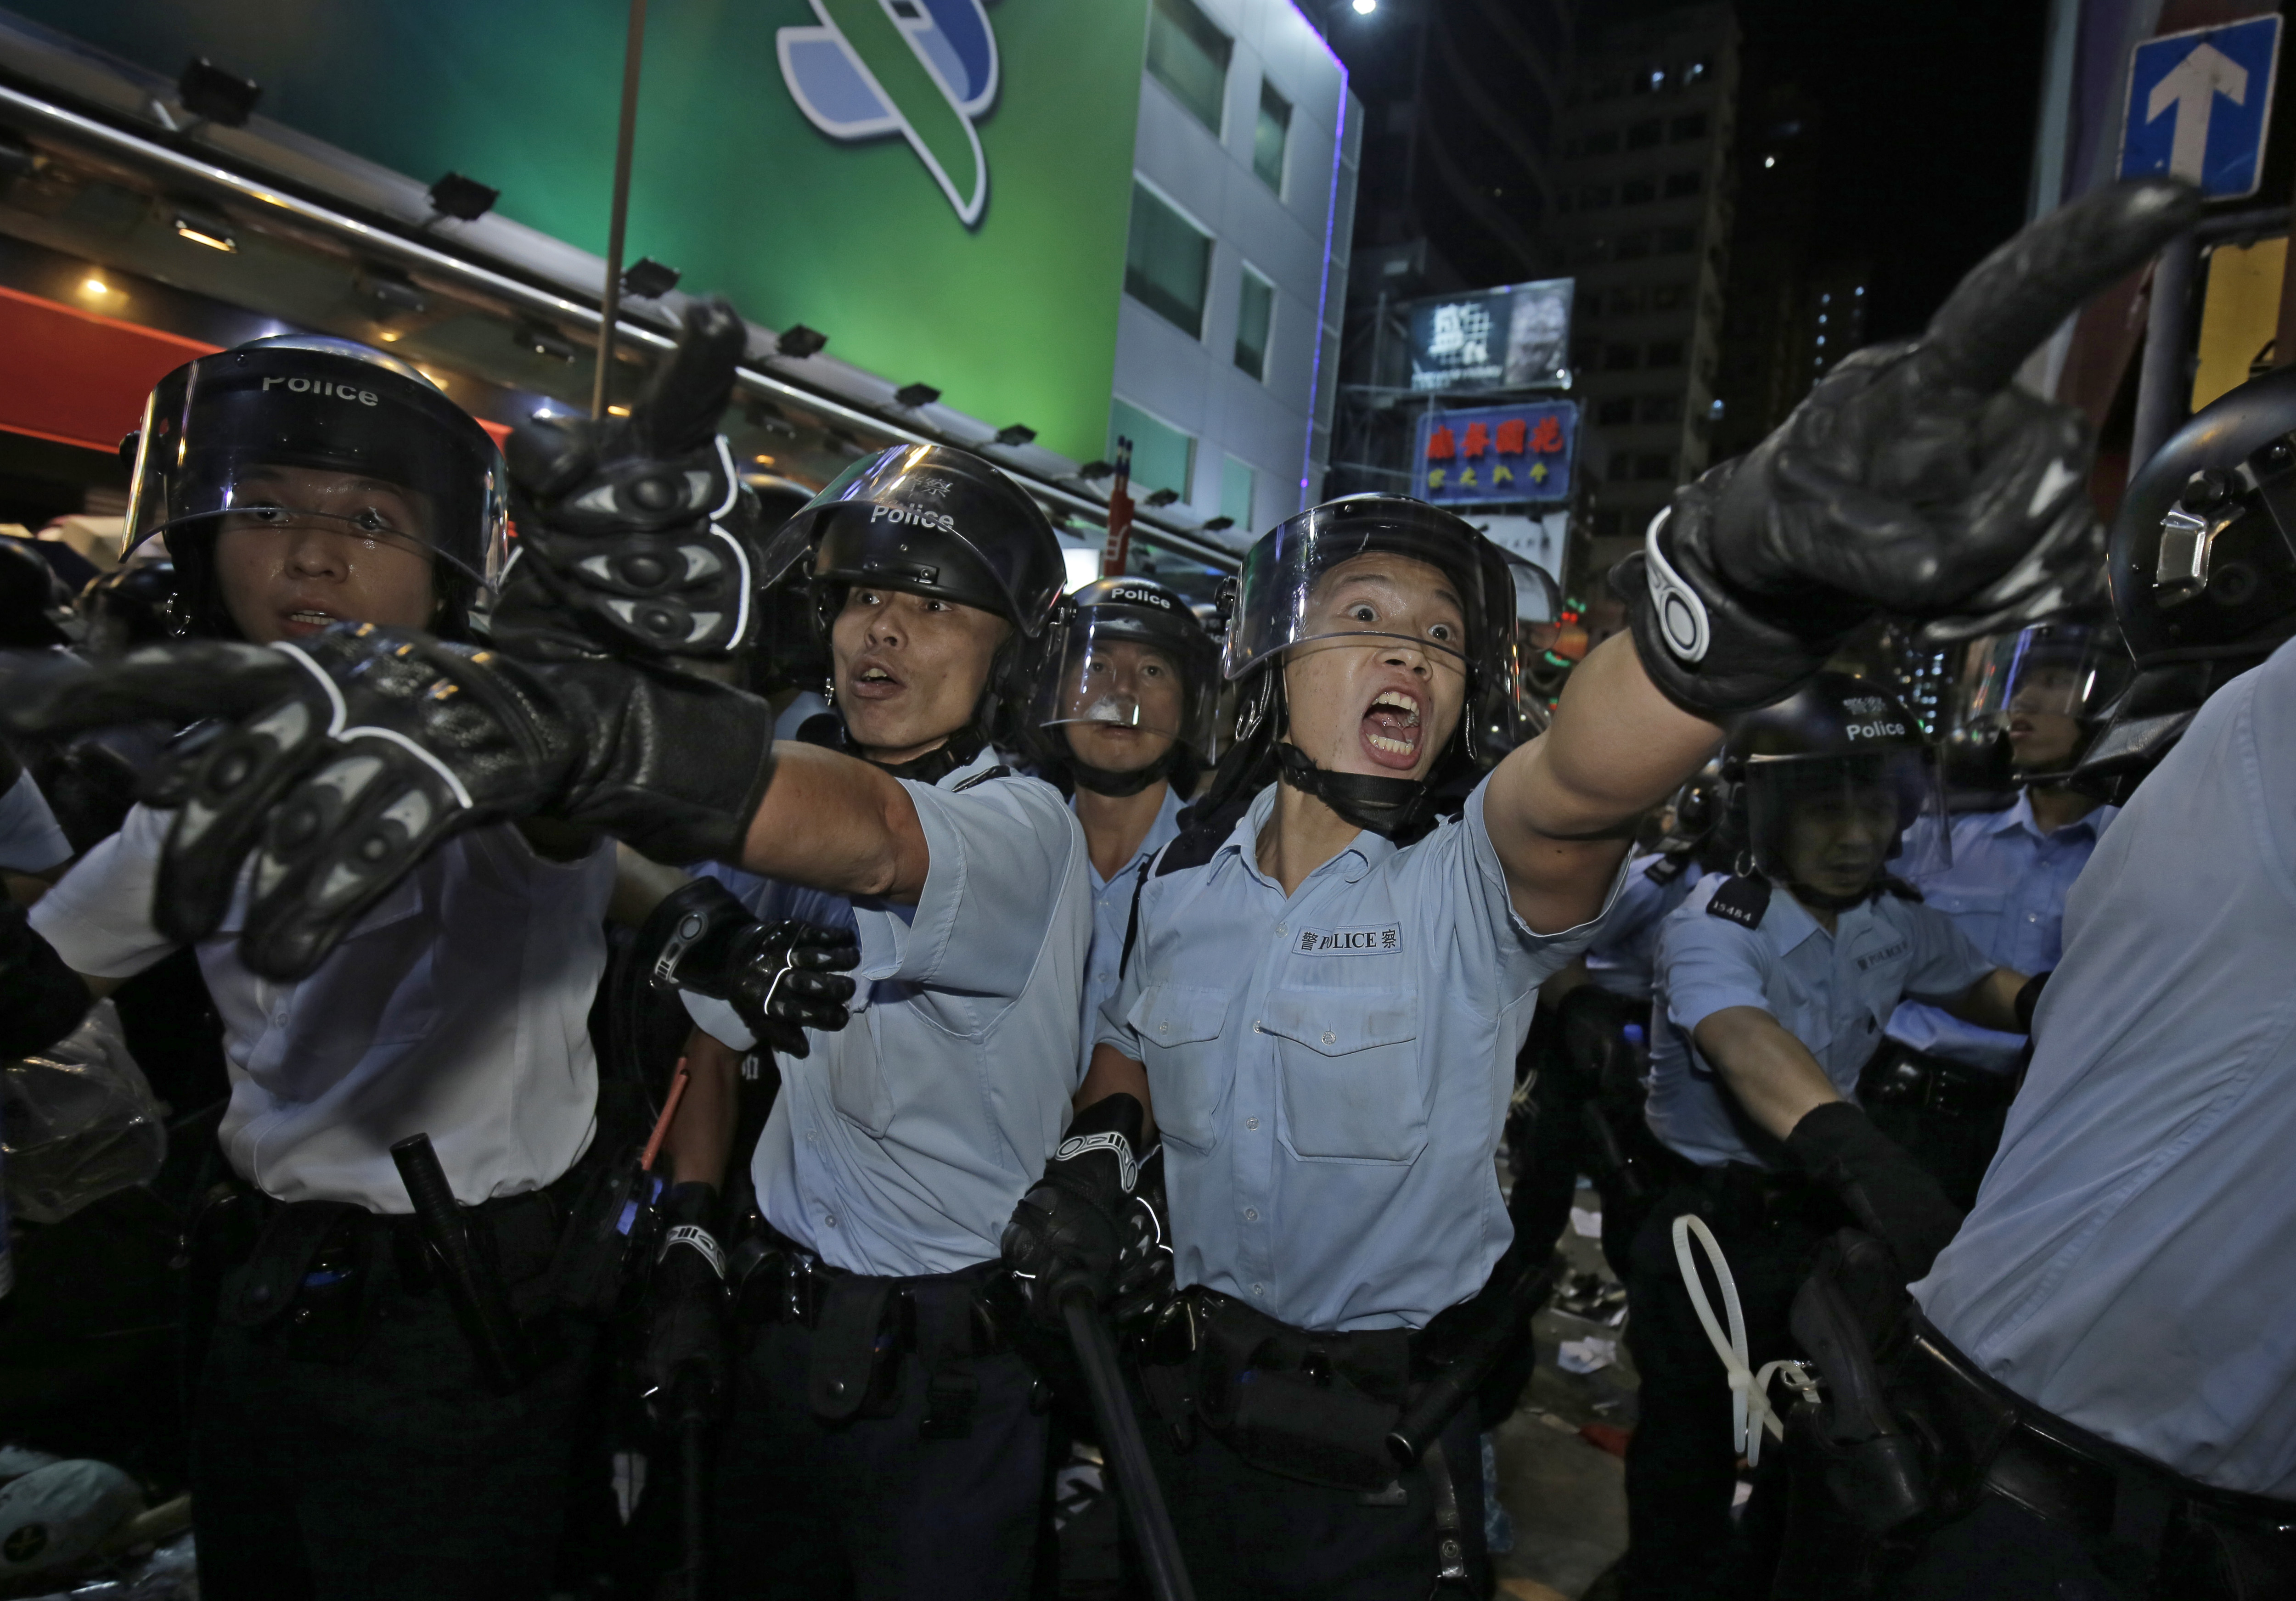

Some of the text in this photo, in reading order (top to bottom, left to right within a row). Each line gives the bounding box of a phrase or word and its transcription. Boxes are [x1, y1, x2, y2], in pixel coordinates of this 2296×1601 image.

[871, 503, 954, 532] Police
[1112, 588, 1170, 609] Police
[1846, 720, 1905, 741] Police
